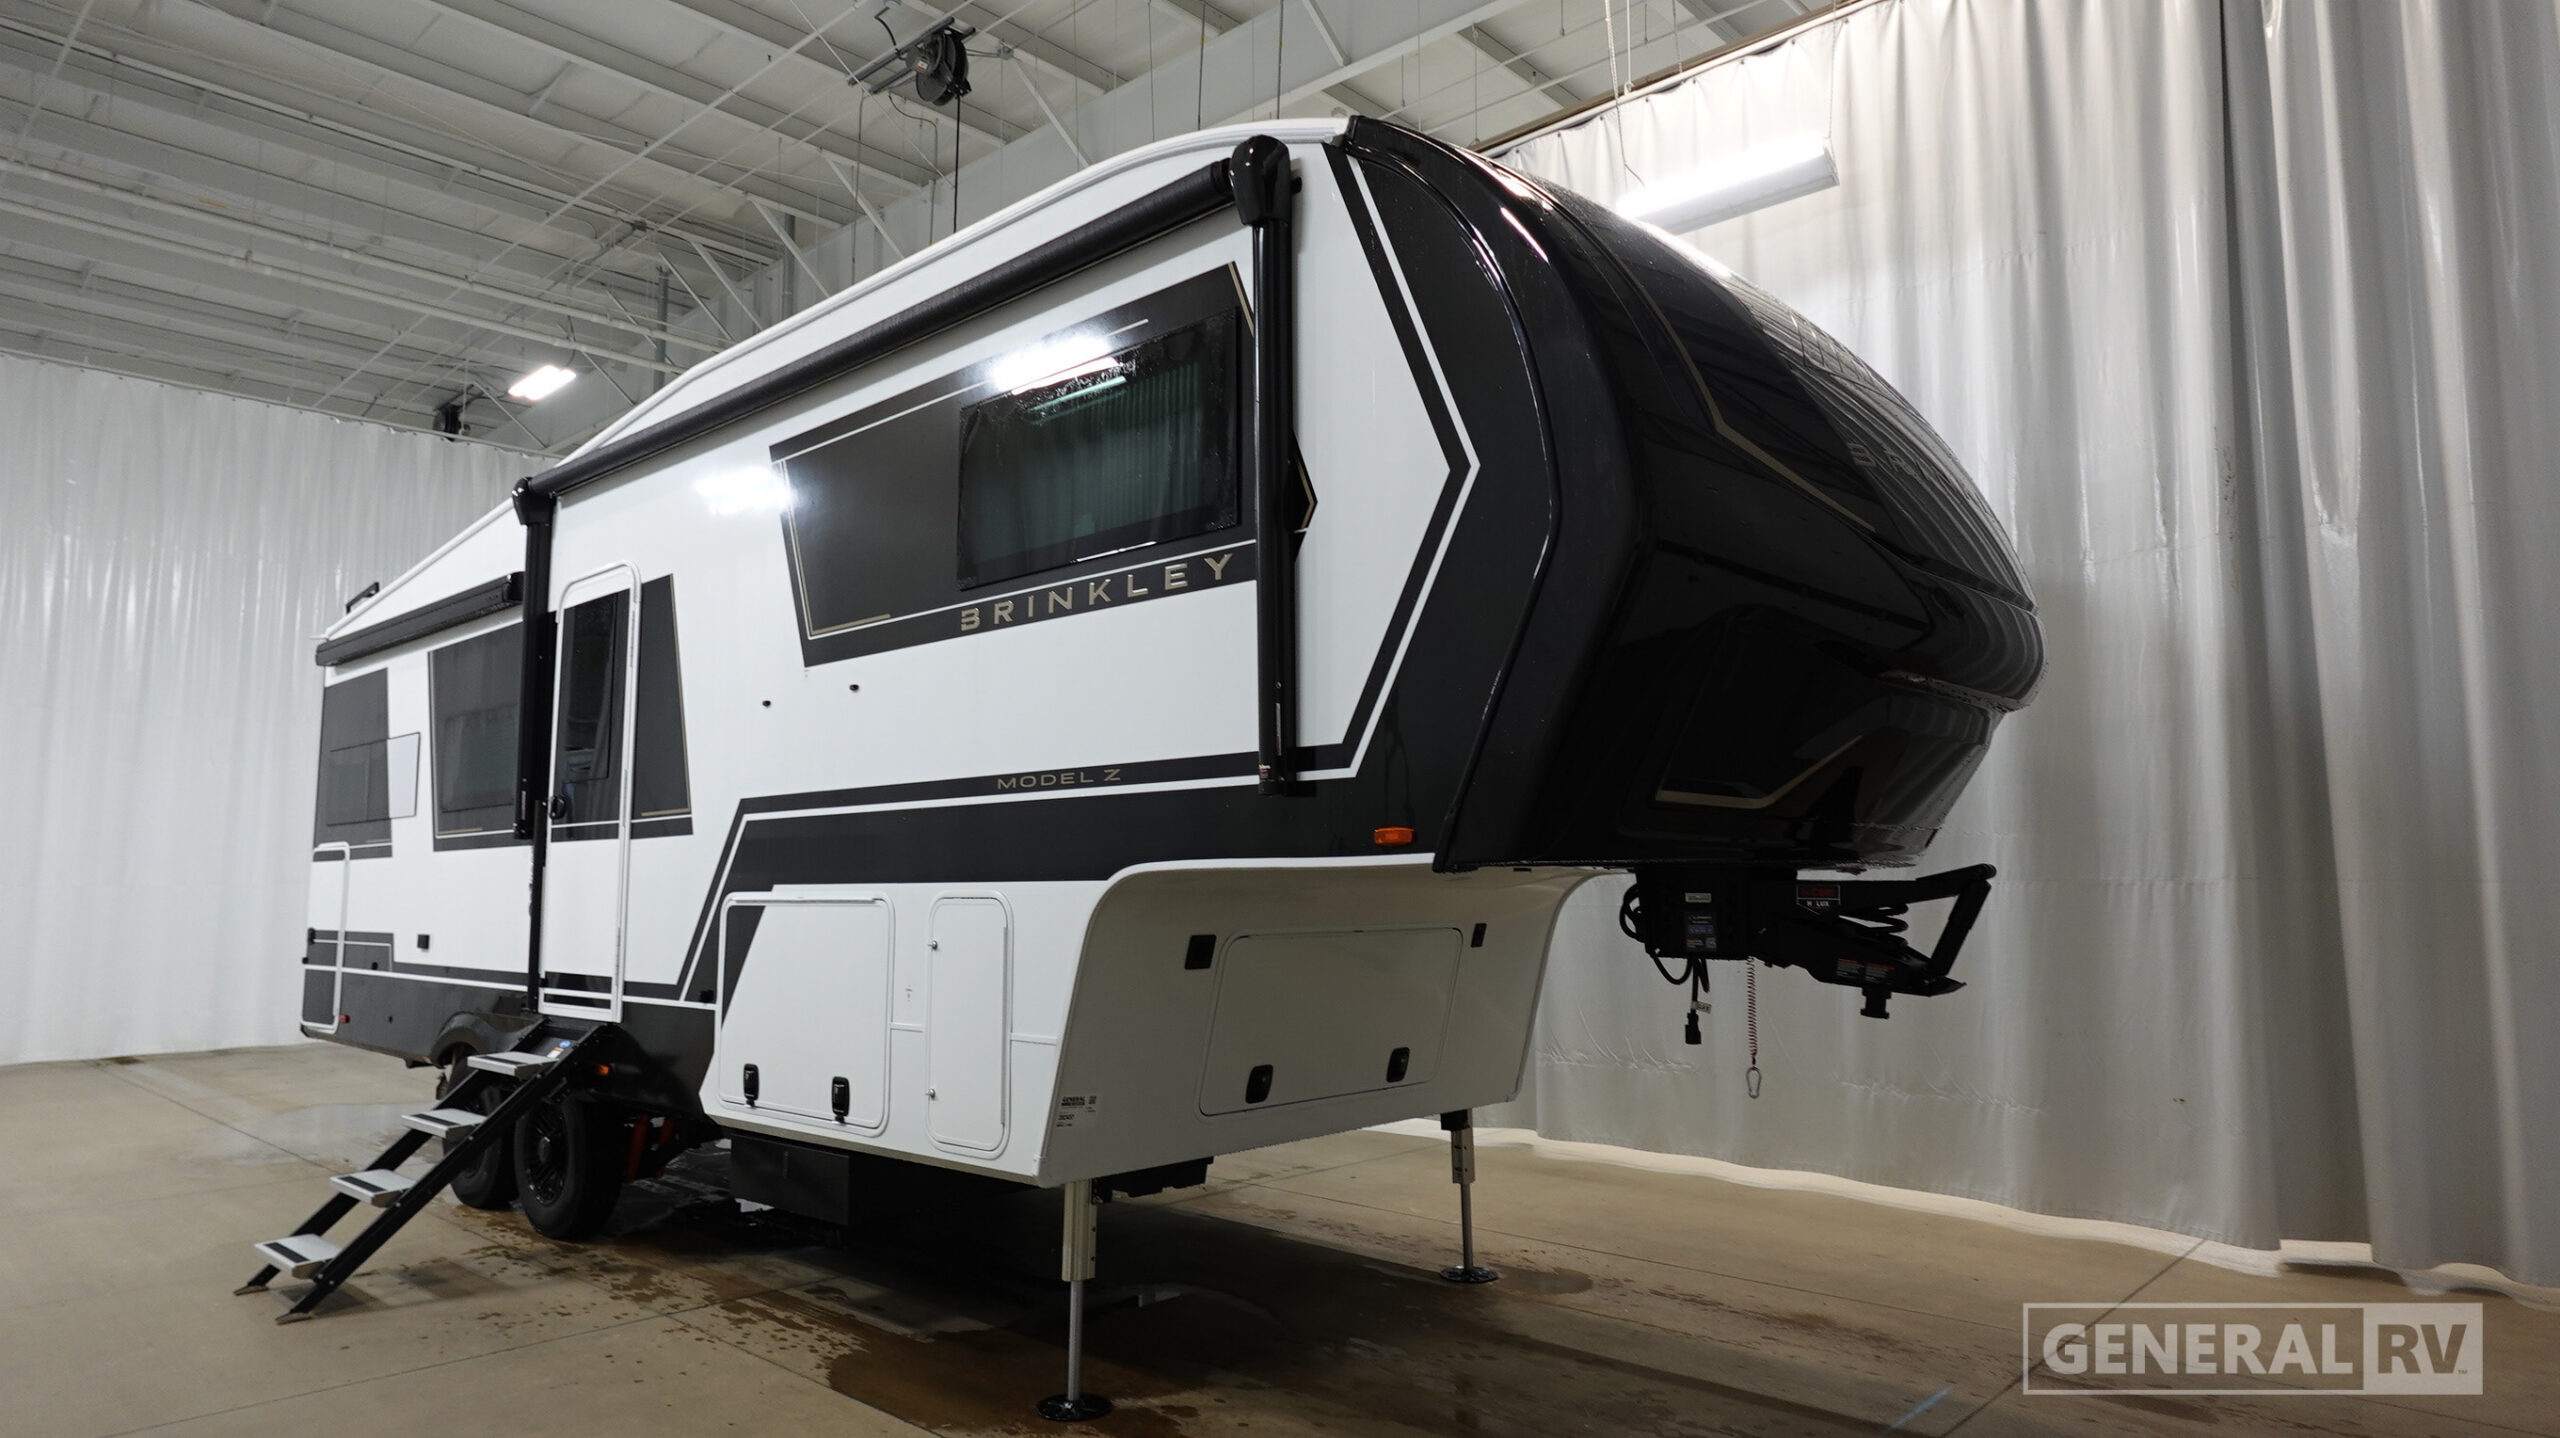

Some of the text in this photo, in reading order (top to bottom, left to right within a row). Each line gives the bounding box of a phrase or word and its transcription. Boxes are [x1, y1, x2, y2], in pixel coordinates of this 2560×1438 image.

[960, 553, 1233, 632] BRINKLEY
[997, 768, 1122, 790] MODEL Z
